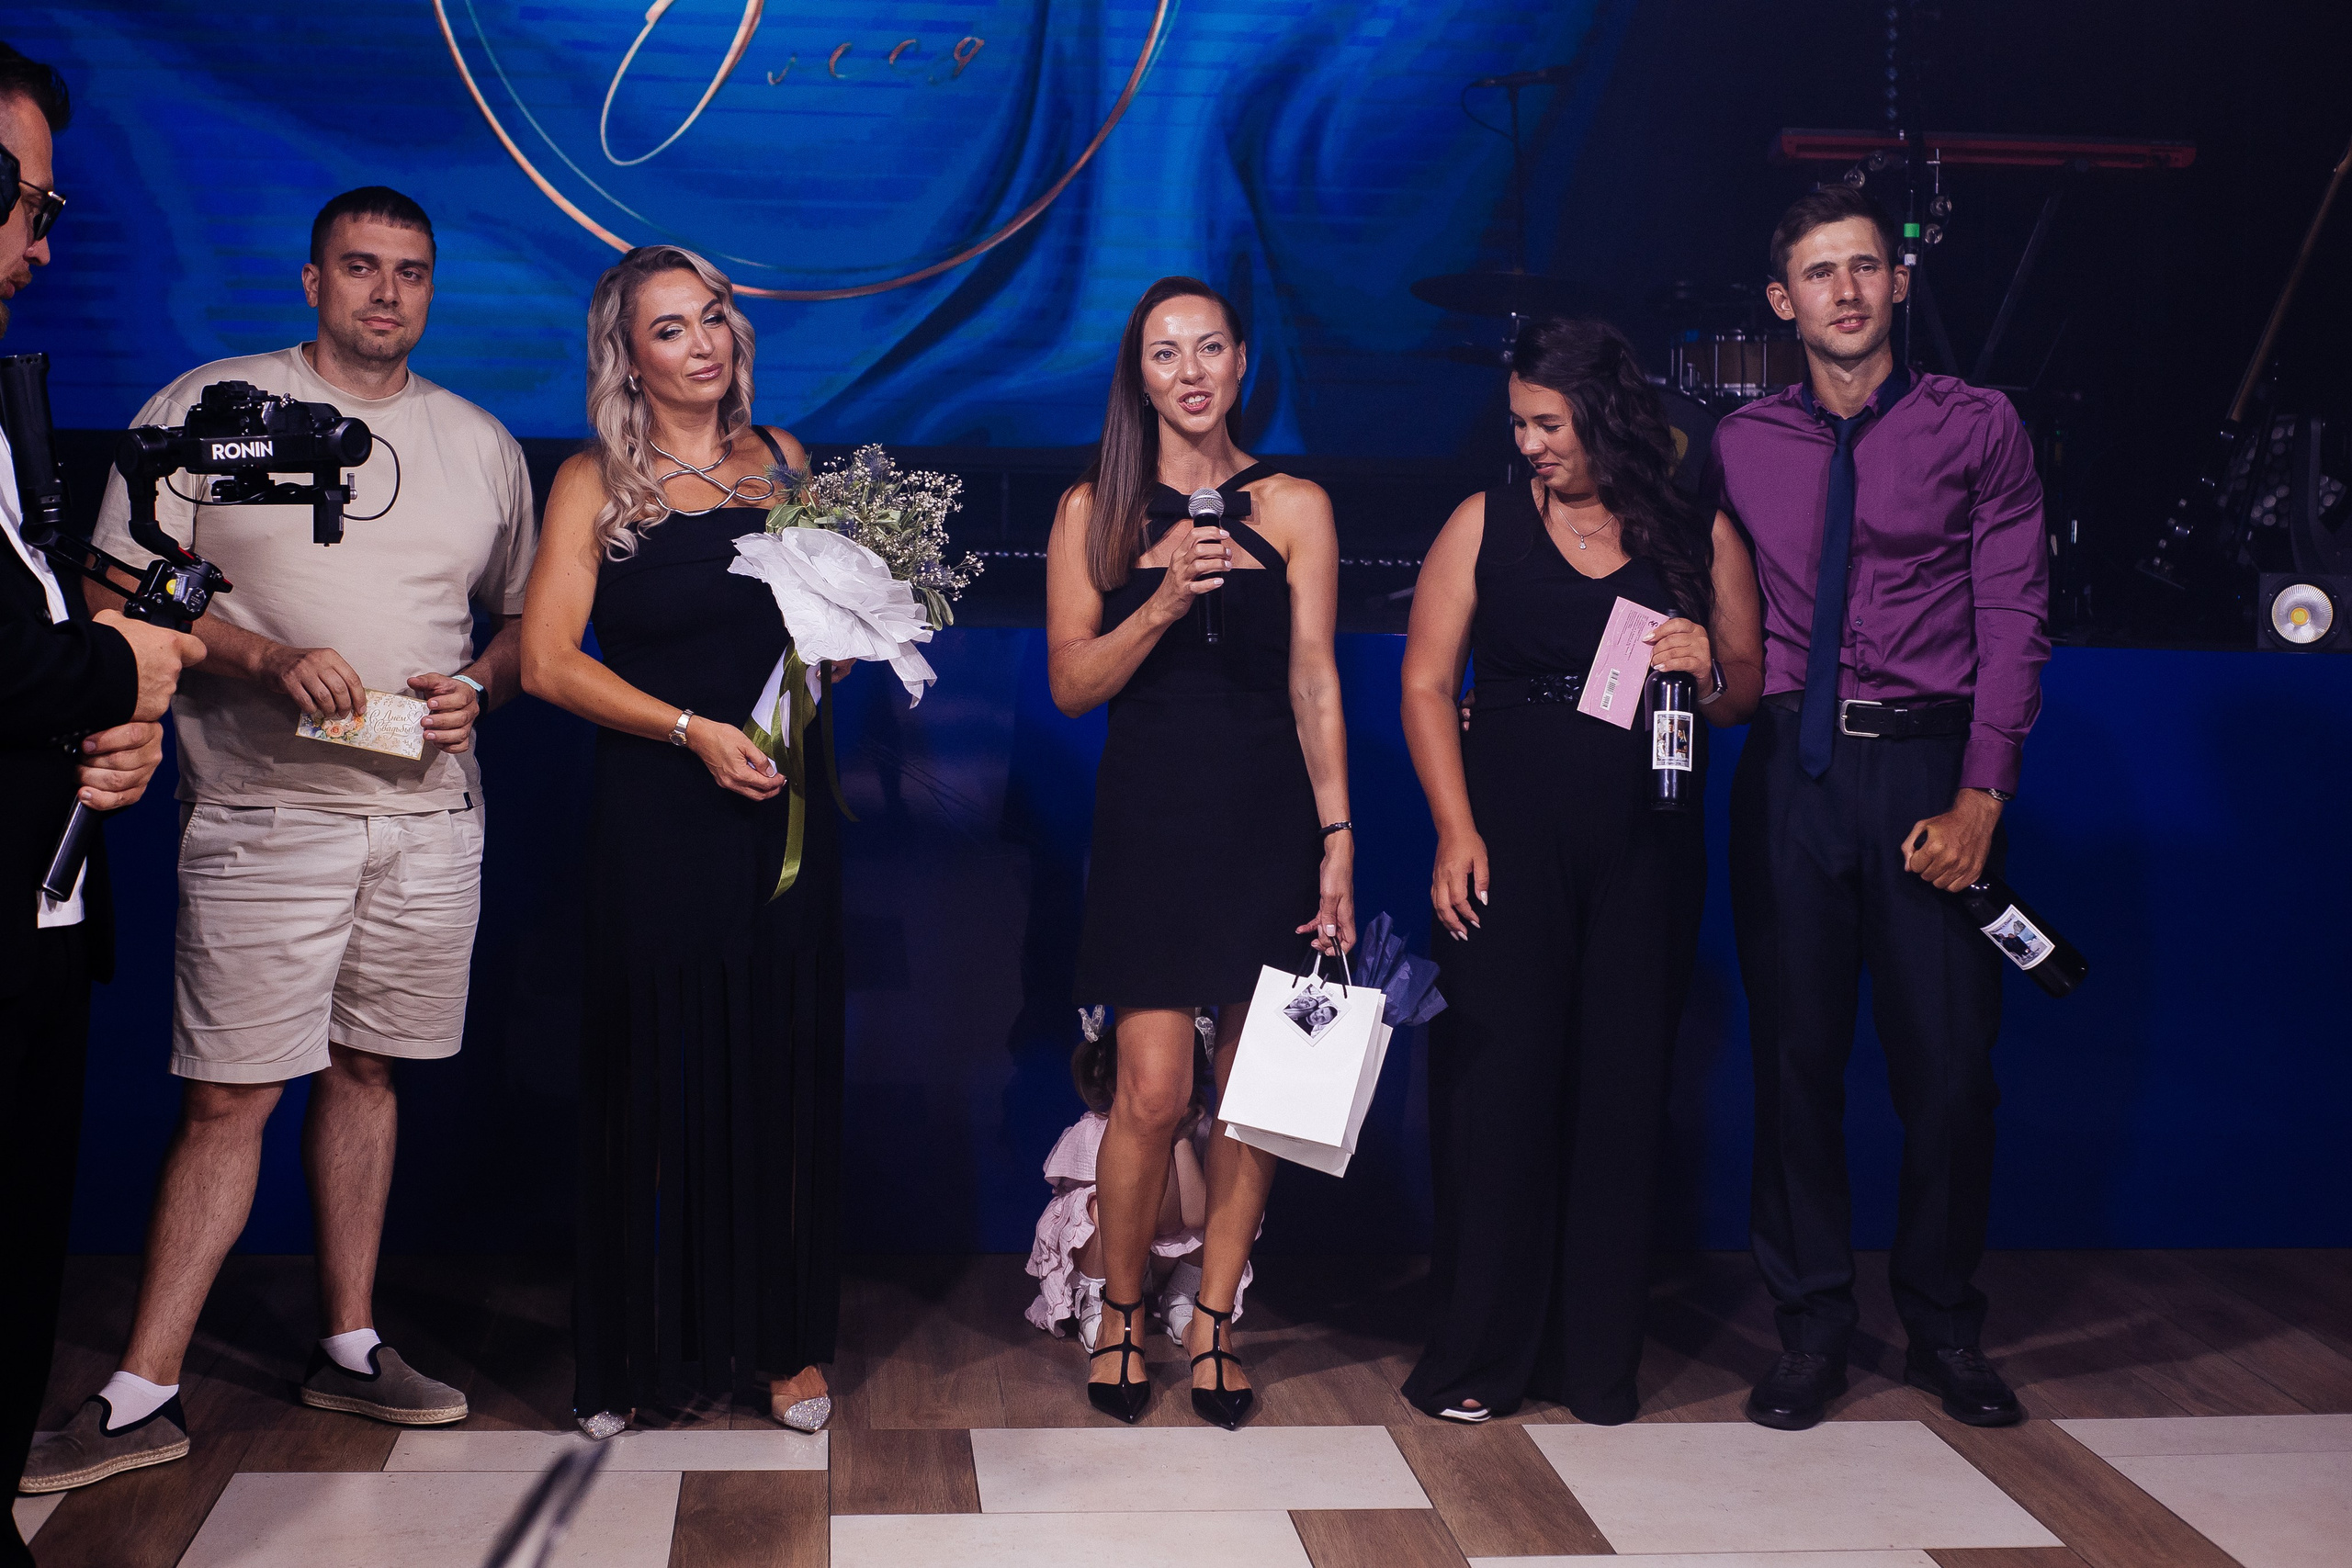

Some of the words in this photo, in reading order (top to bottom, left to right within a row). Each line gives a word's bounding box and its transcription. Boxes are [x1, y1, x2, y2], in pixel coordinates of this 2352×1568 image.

[211, 440, 274, 460] RONIN
[381, 709, 408, 723] Днём
[373, 718, 413, 739] Свадьбы!
